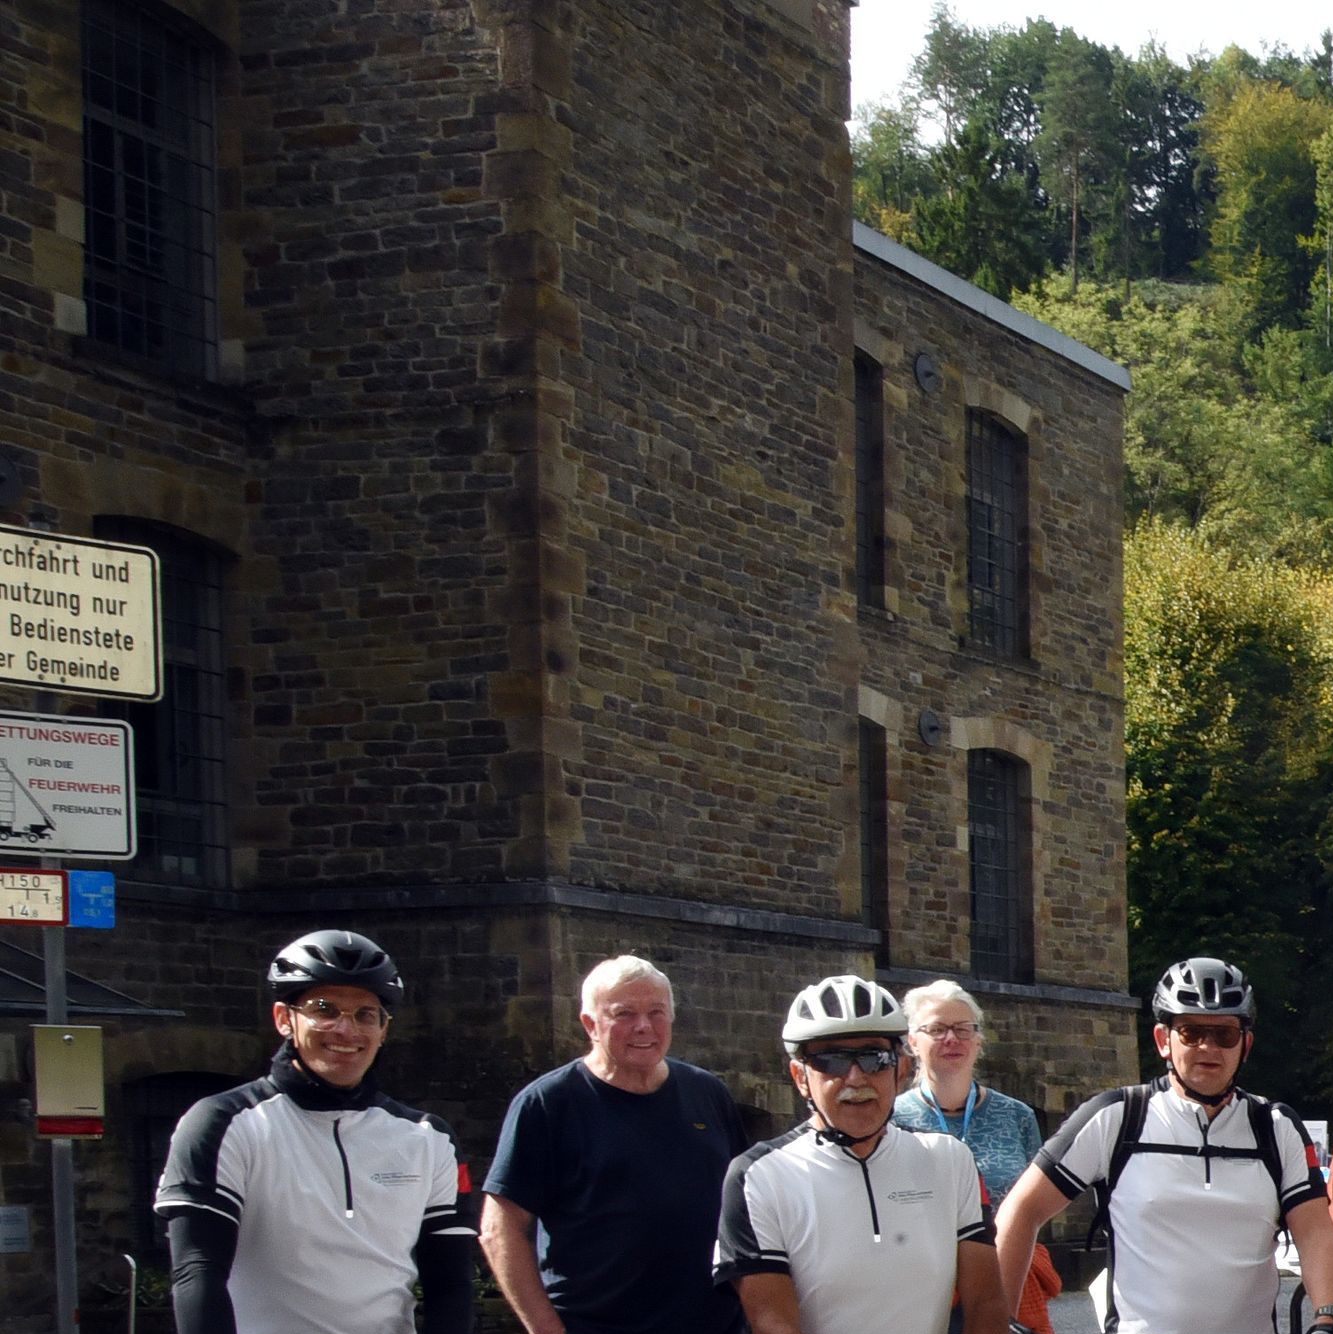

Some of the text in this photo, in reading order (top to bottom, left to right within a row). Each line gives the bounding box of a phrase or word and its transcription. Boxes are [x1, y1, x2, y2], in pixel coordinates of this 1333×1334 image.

[0, 544, 130, 584] chfahrt und
[92, 596, 128, 617] nur
[10, 613, 134, 651] Bedienstete
[26, 650, 120, 681] Gemeinde
[27, 756, 74, 770] FÜR DIE
[28, 778, 121, 795] FEUERWEHR
[52, 804, 122, 816] FREIHALTEN
